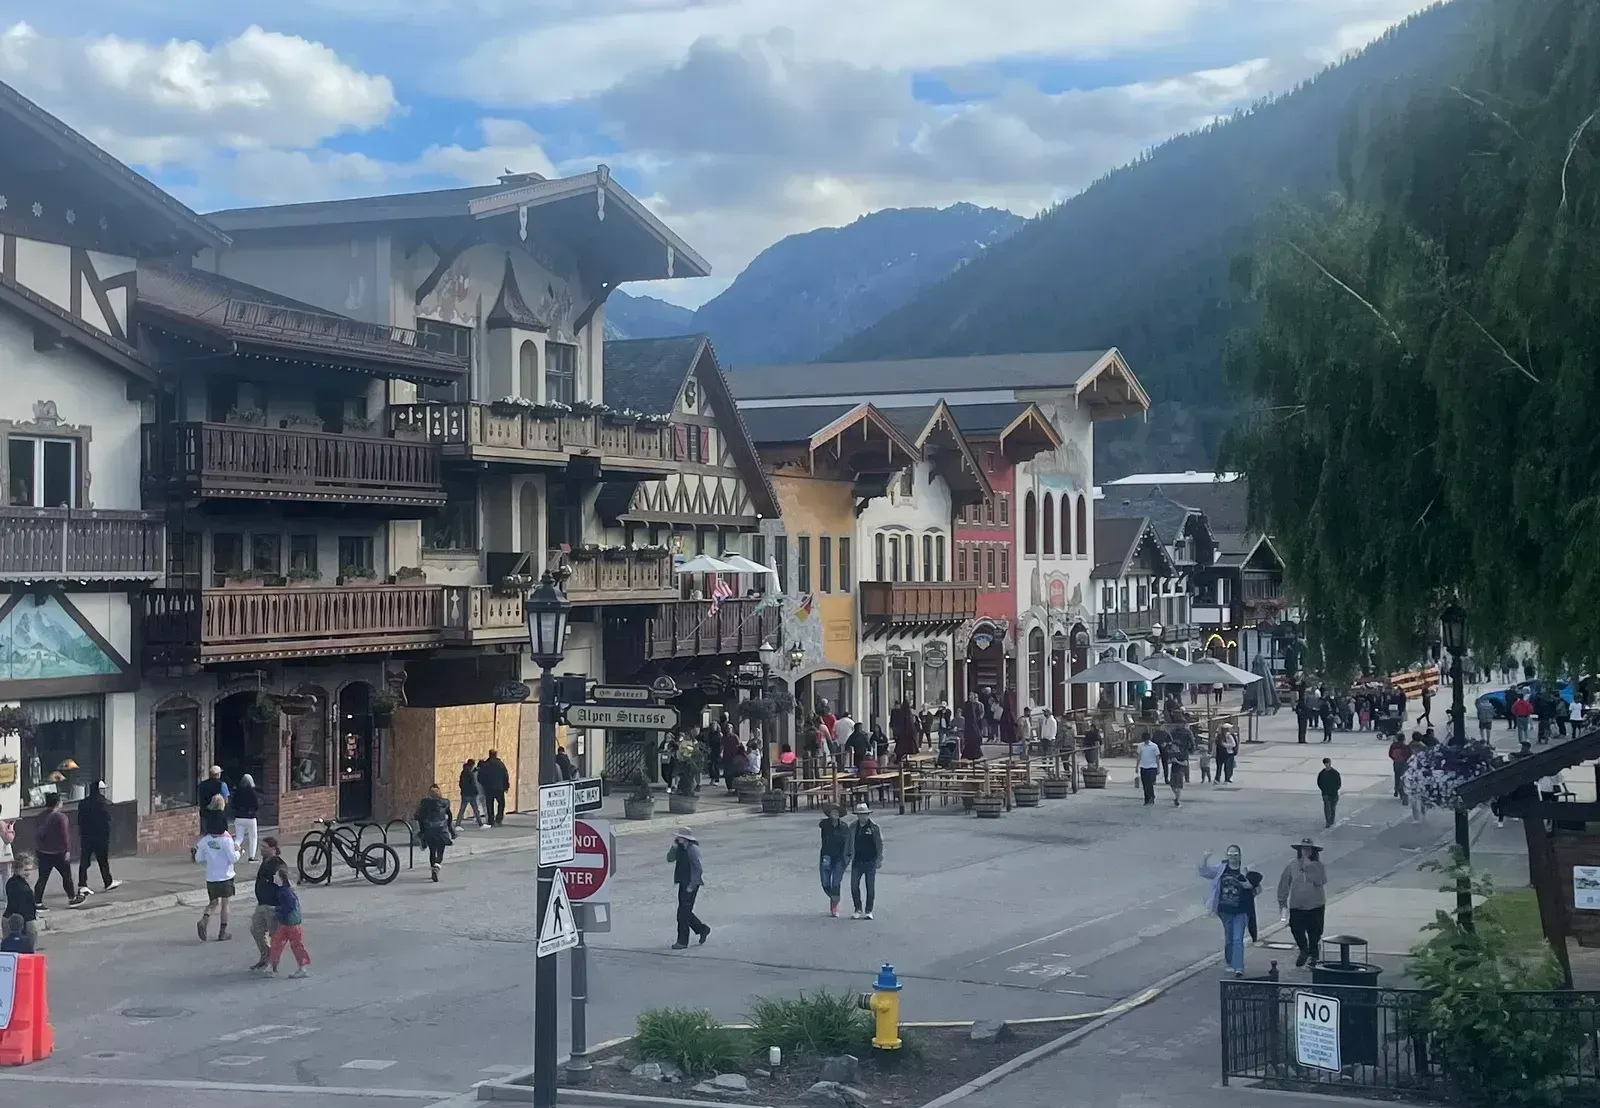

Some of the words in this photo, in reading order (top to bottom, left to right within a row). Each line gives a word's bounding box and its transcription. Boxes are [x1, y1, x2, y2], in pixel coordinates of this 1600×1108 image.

[577, 709, 611, 723] Alpen
[616, 710, 666, 724] Strasse
[586, 787, 599, 801] WAY
[574, 835, 598, 848] NOT
[561, 871, 593, 885] NTER
[1304, 1001, 1330, 1023] NO
